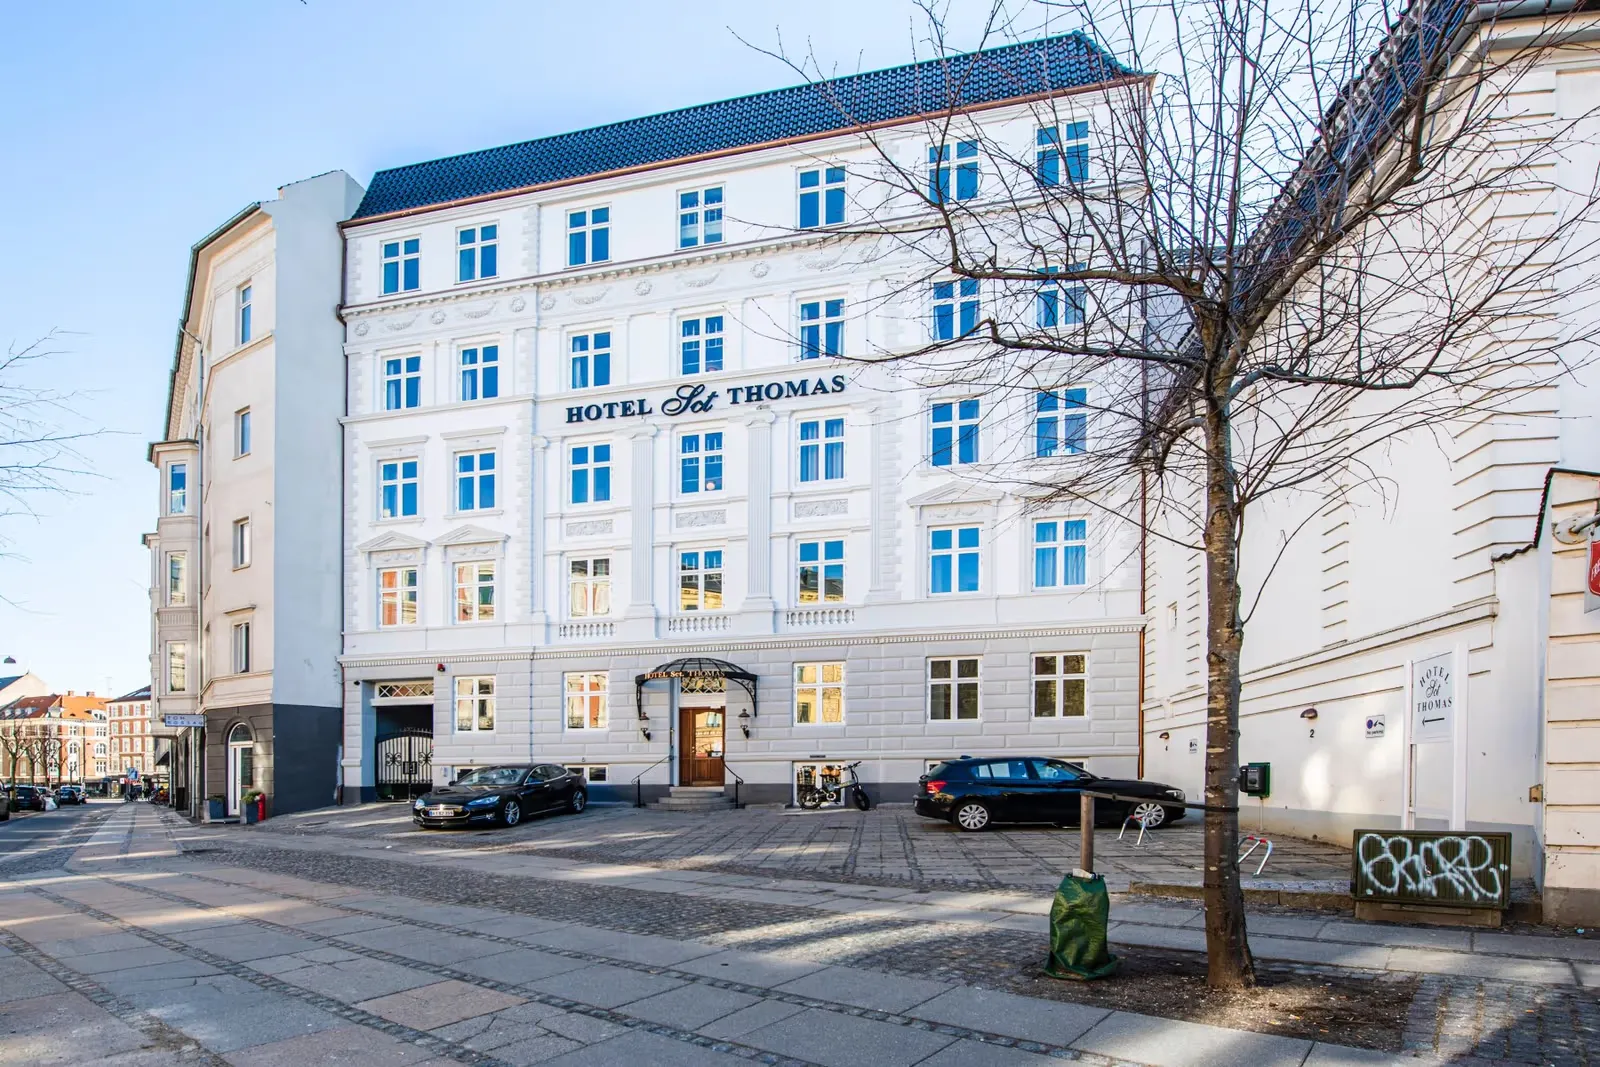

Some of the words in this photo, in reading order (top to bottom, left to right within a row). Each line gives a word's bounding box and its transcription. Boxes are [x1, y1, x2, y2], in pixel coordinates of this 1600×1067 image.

[565, 398, 653, 424] HOTEL
[661, 384, 718, 417] Sct
[727, 374, 846, 405] THOMAS
[644, 671, 668, 680] HOTEL
[687, 670, 725, 678] THOMAS
[1419, 665, 1450, 688] HOTEL
[1417, 696, 1453, 713] THOMAS
[1309, 729, 1315, 738] 2
